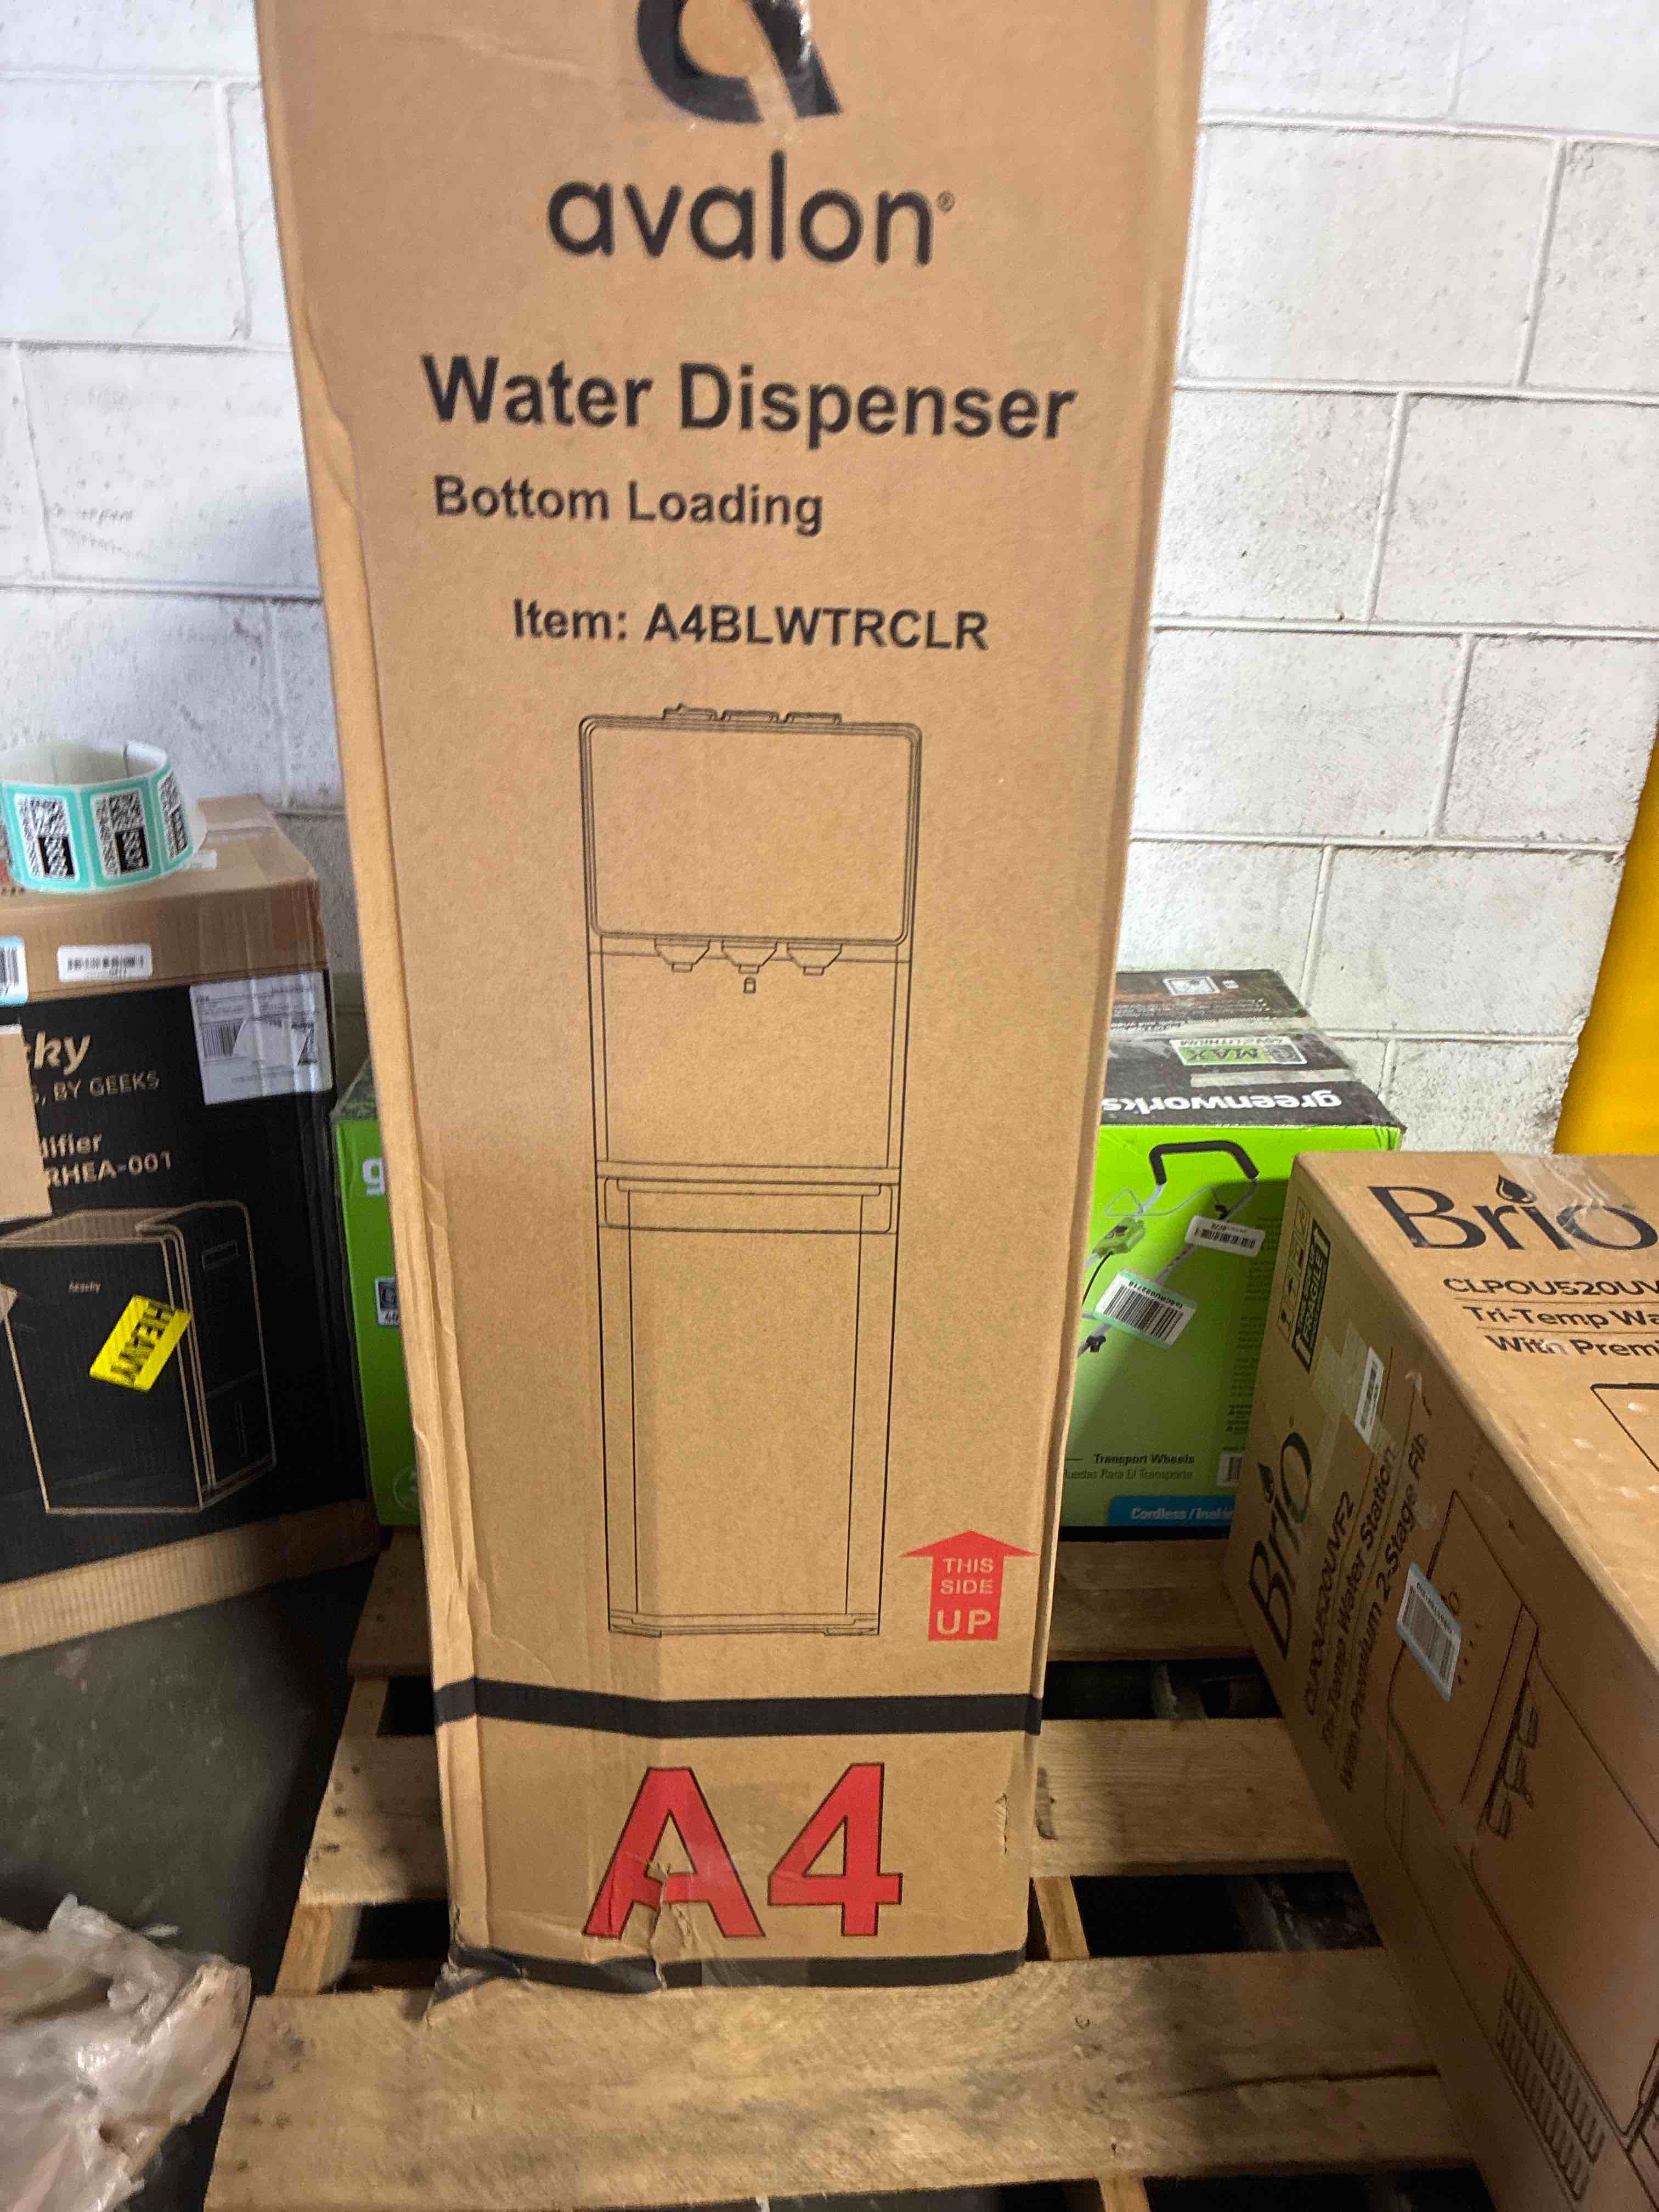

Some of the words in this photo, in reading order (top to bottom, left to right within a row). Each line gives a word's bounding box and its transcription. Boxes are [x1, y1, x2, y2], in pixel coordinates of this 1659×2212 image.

[422, 354, 653, 429] Water
[680, 362, 1079, 450] Dispenser
[433, 475, 610, 521] Bottom
[629, 479, 823, 538] Loading
[515, 599, 628, 644] Item:
[646, 605, 990, 653] A4BLWTRCLR
[89, 1071, 160, 1097] GEEKS
[1101, 1089, 1342, 1115] greenworks
[1367, 1175, 1658, 1251] Brio
[1463, 1306, 1609, 1329] Tri-Temp
[1485, 1334, 1568, 1356] With
[1092, 1453, 1148, 1466] Transport
[1150, 1453, 1195, 1464] Wheels
[1248, 1431, 1312, 1661] Brio
[942, 1556, 994, 1574] THIS
[939, 1578, 994, 1595] SIDE
[935, 1608, 991, 1635] UP
[583, 1762, 904, 1940] A4
